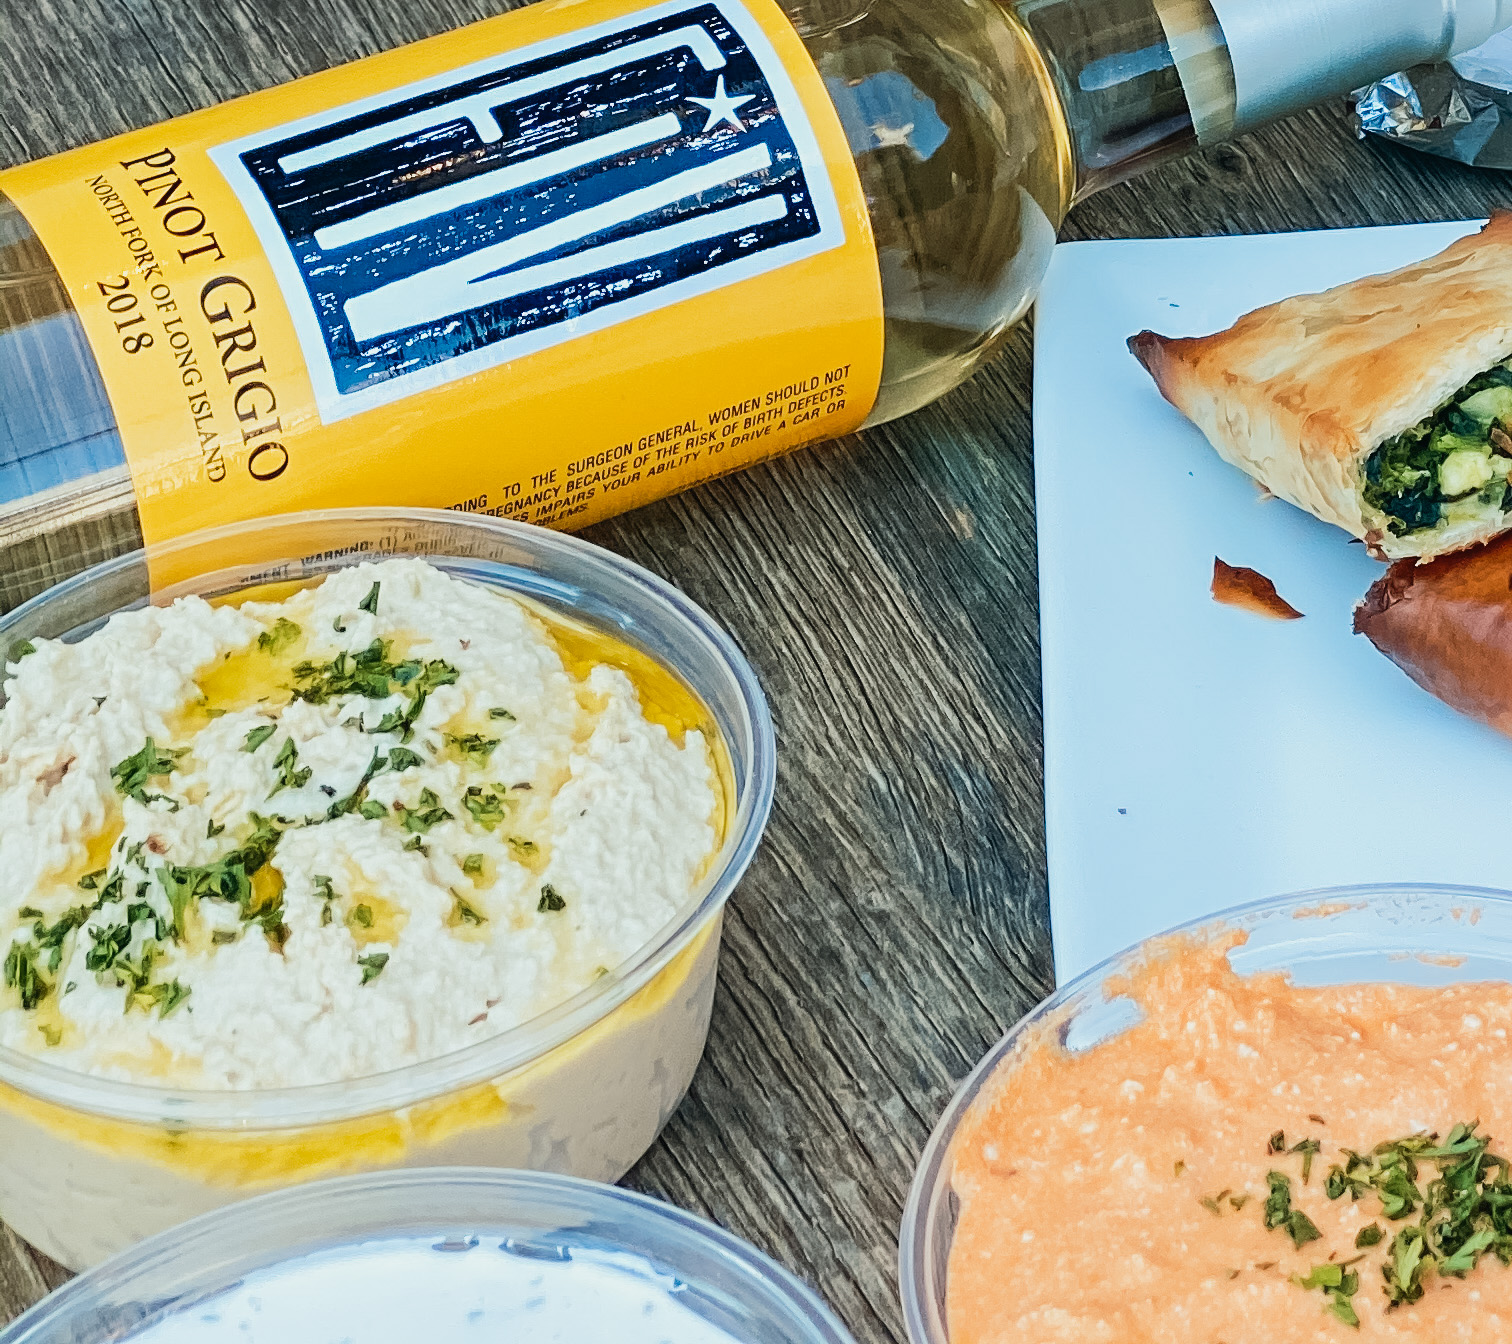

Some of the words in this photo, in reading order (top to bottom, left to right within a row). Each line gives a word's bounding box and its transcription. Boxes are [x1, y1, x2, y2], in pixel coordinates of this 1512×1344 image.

[85, 174, 137, 227] NORTH
[120, 217, 164, 282] FORK
[97, 274, 155, 355] 2018
[119, 147, 226, 264] PINOT
[200, 275, 289, 481] GRIGIO
[150, 283, 177, 313] OF
[163, 317, 203, 387] LONG
[187, 390, 228, 483] ISLAND
[502, 482, 521, 499] TO
[531, 469, 558, 489] THE
[566, 442, 633, 477] SURGEON
[708, 397, 761, 425] WOMEN
[765, 376, 819, 406] SHOULD
[824, 364, 851, 384] NOT
[535, 487, 595, 517] IMPAIRS
[602, 471, 641, 493] YOUR
[646, 451, 701, 477] ABILITY
[707, 441, 725, 456] TO
[730, 426, 771, 448] DRIVE
[777, 420, 787, 431] A
[792, 408, 821, 425] CAR
[826, 399, 846, 414] OR
[566, 461, 628, 493] BECAUSE
[633, 452, 650, 469] OF
[656, 442, 681, 461] THE
[685, 428, 717, 450] RISK
[722, 421, 739, 438] OF
[743, 406, 783, 430] BIRTH
